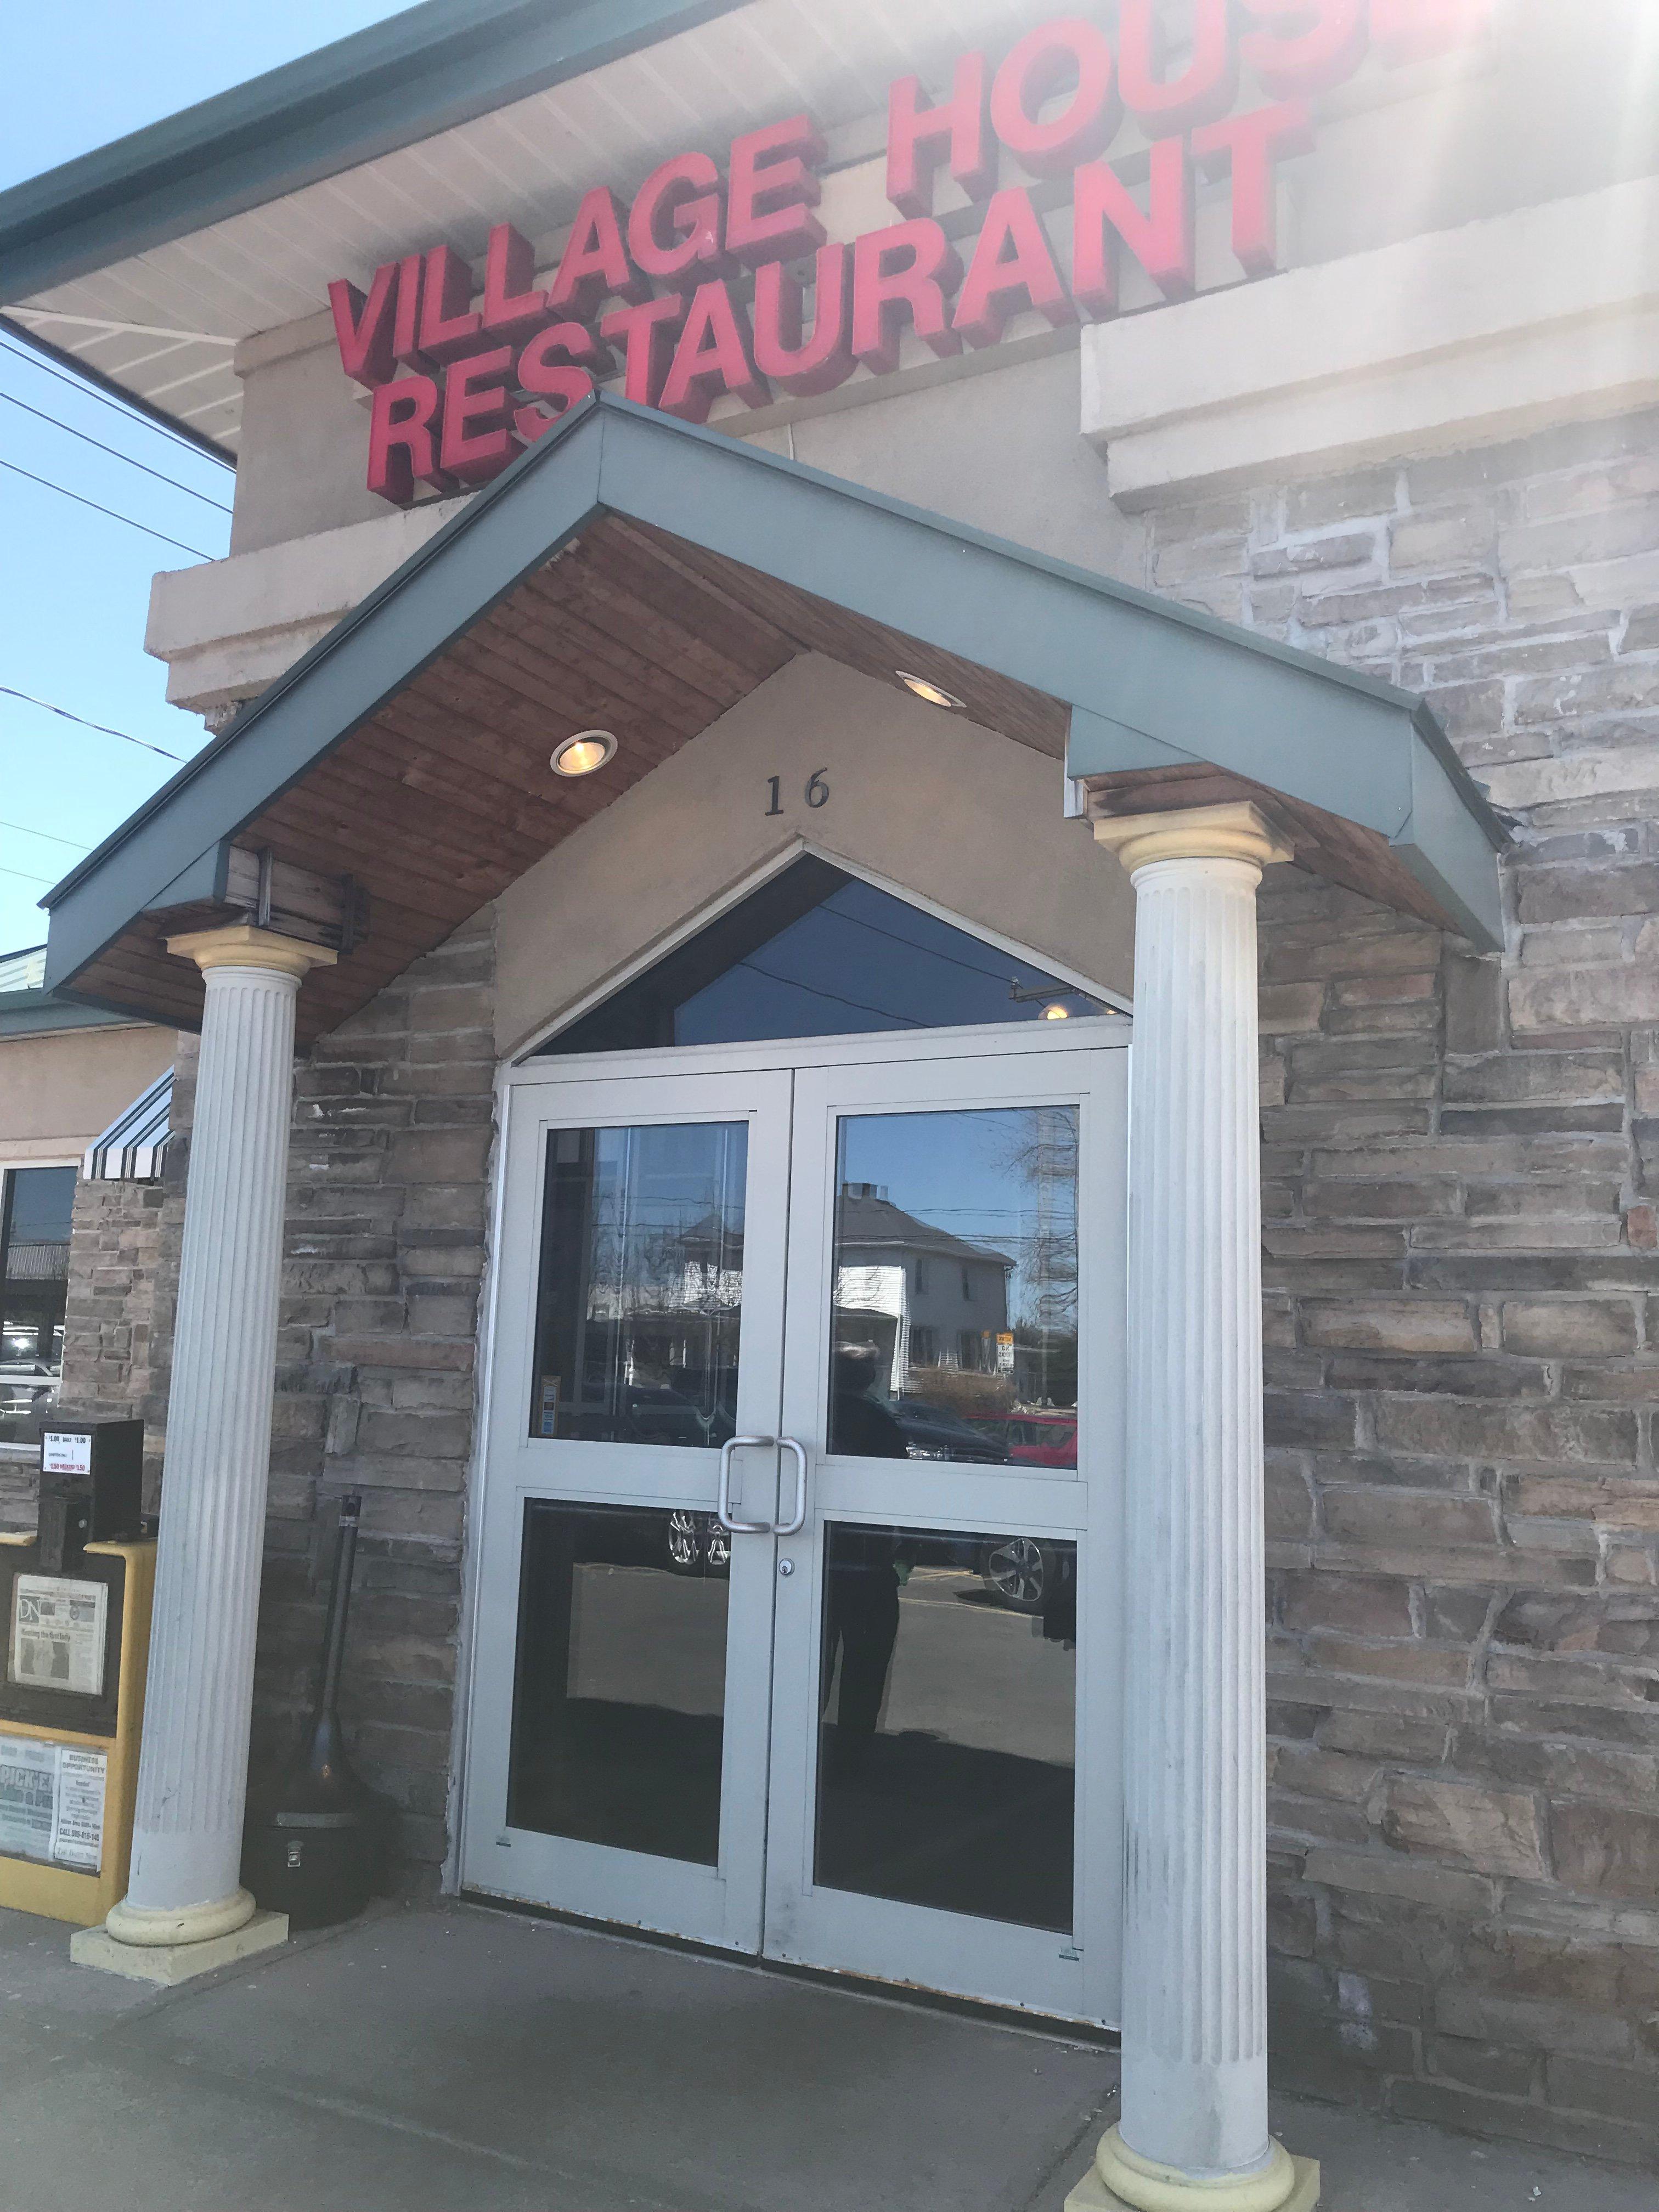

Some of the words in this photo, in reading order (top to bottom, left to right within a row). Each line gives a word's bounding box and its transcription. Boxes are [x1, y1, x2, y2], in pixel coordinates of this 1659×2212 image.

[328, 114, 827, 391] VILLAGE
[366, 100, 1314, 510] RESTAURANT
[63, 1762, 105, 1774] OPPORTUNITY
[69, 1754, 99, 1765] BUSINESS
